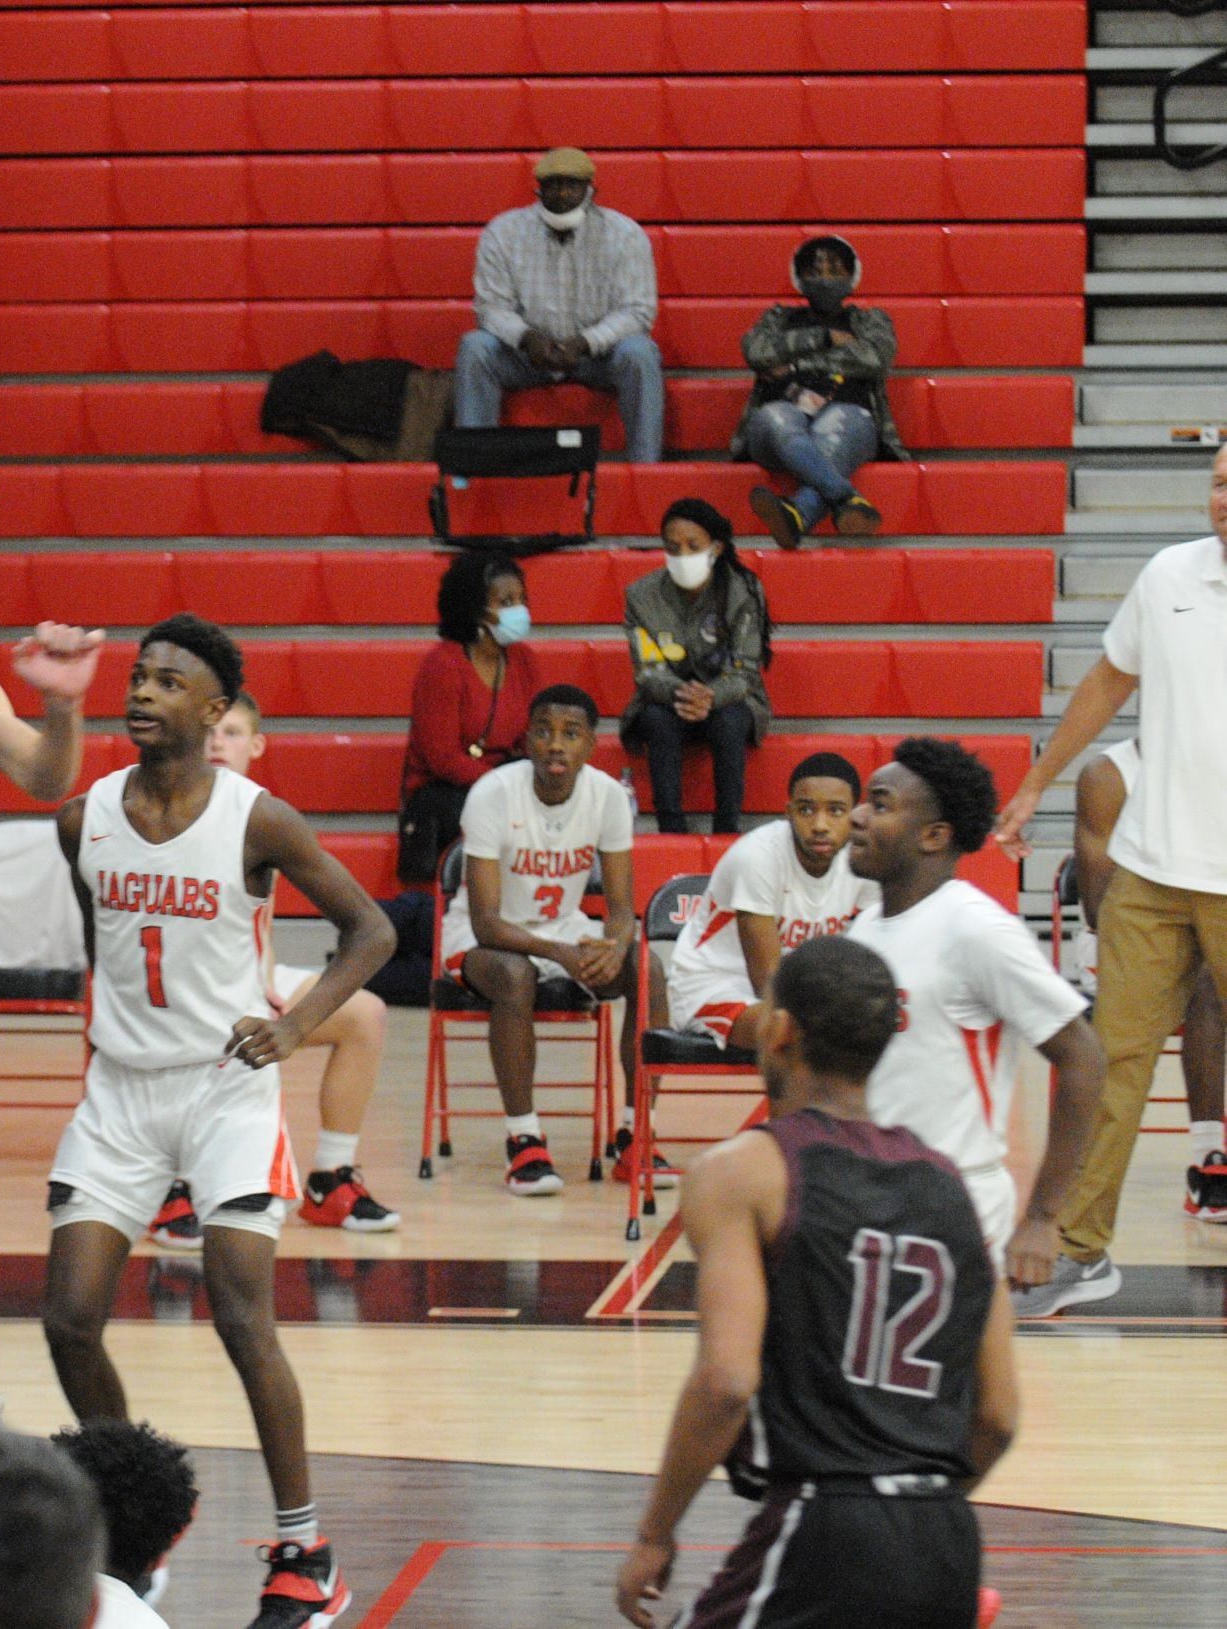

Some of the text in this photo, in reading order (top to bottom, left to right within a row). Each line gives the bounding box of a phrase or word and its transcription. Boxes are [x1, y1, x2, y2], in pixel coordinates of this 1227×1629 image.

[510, 844, 596, 879] JAGUARS
[97, 870, 221, 920] JAGUARS
[140, 925, 169, 1008] 1
[840, 1227, 957, 1399] 12
